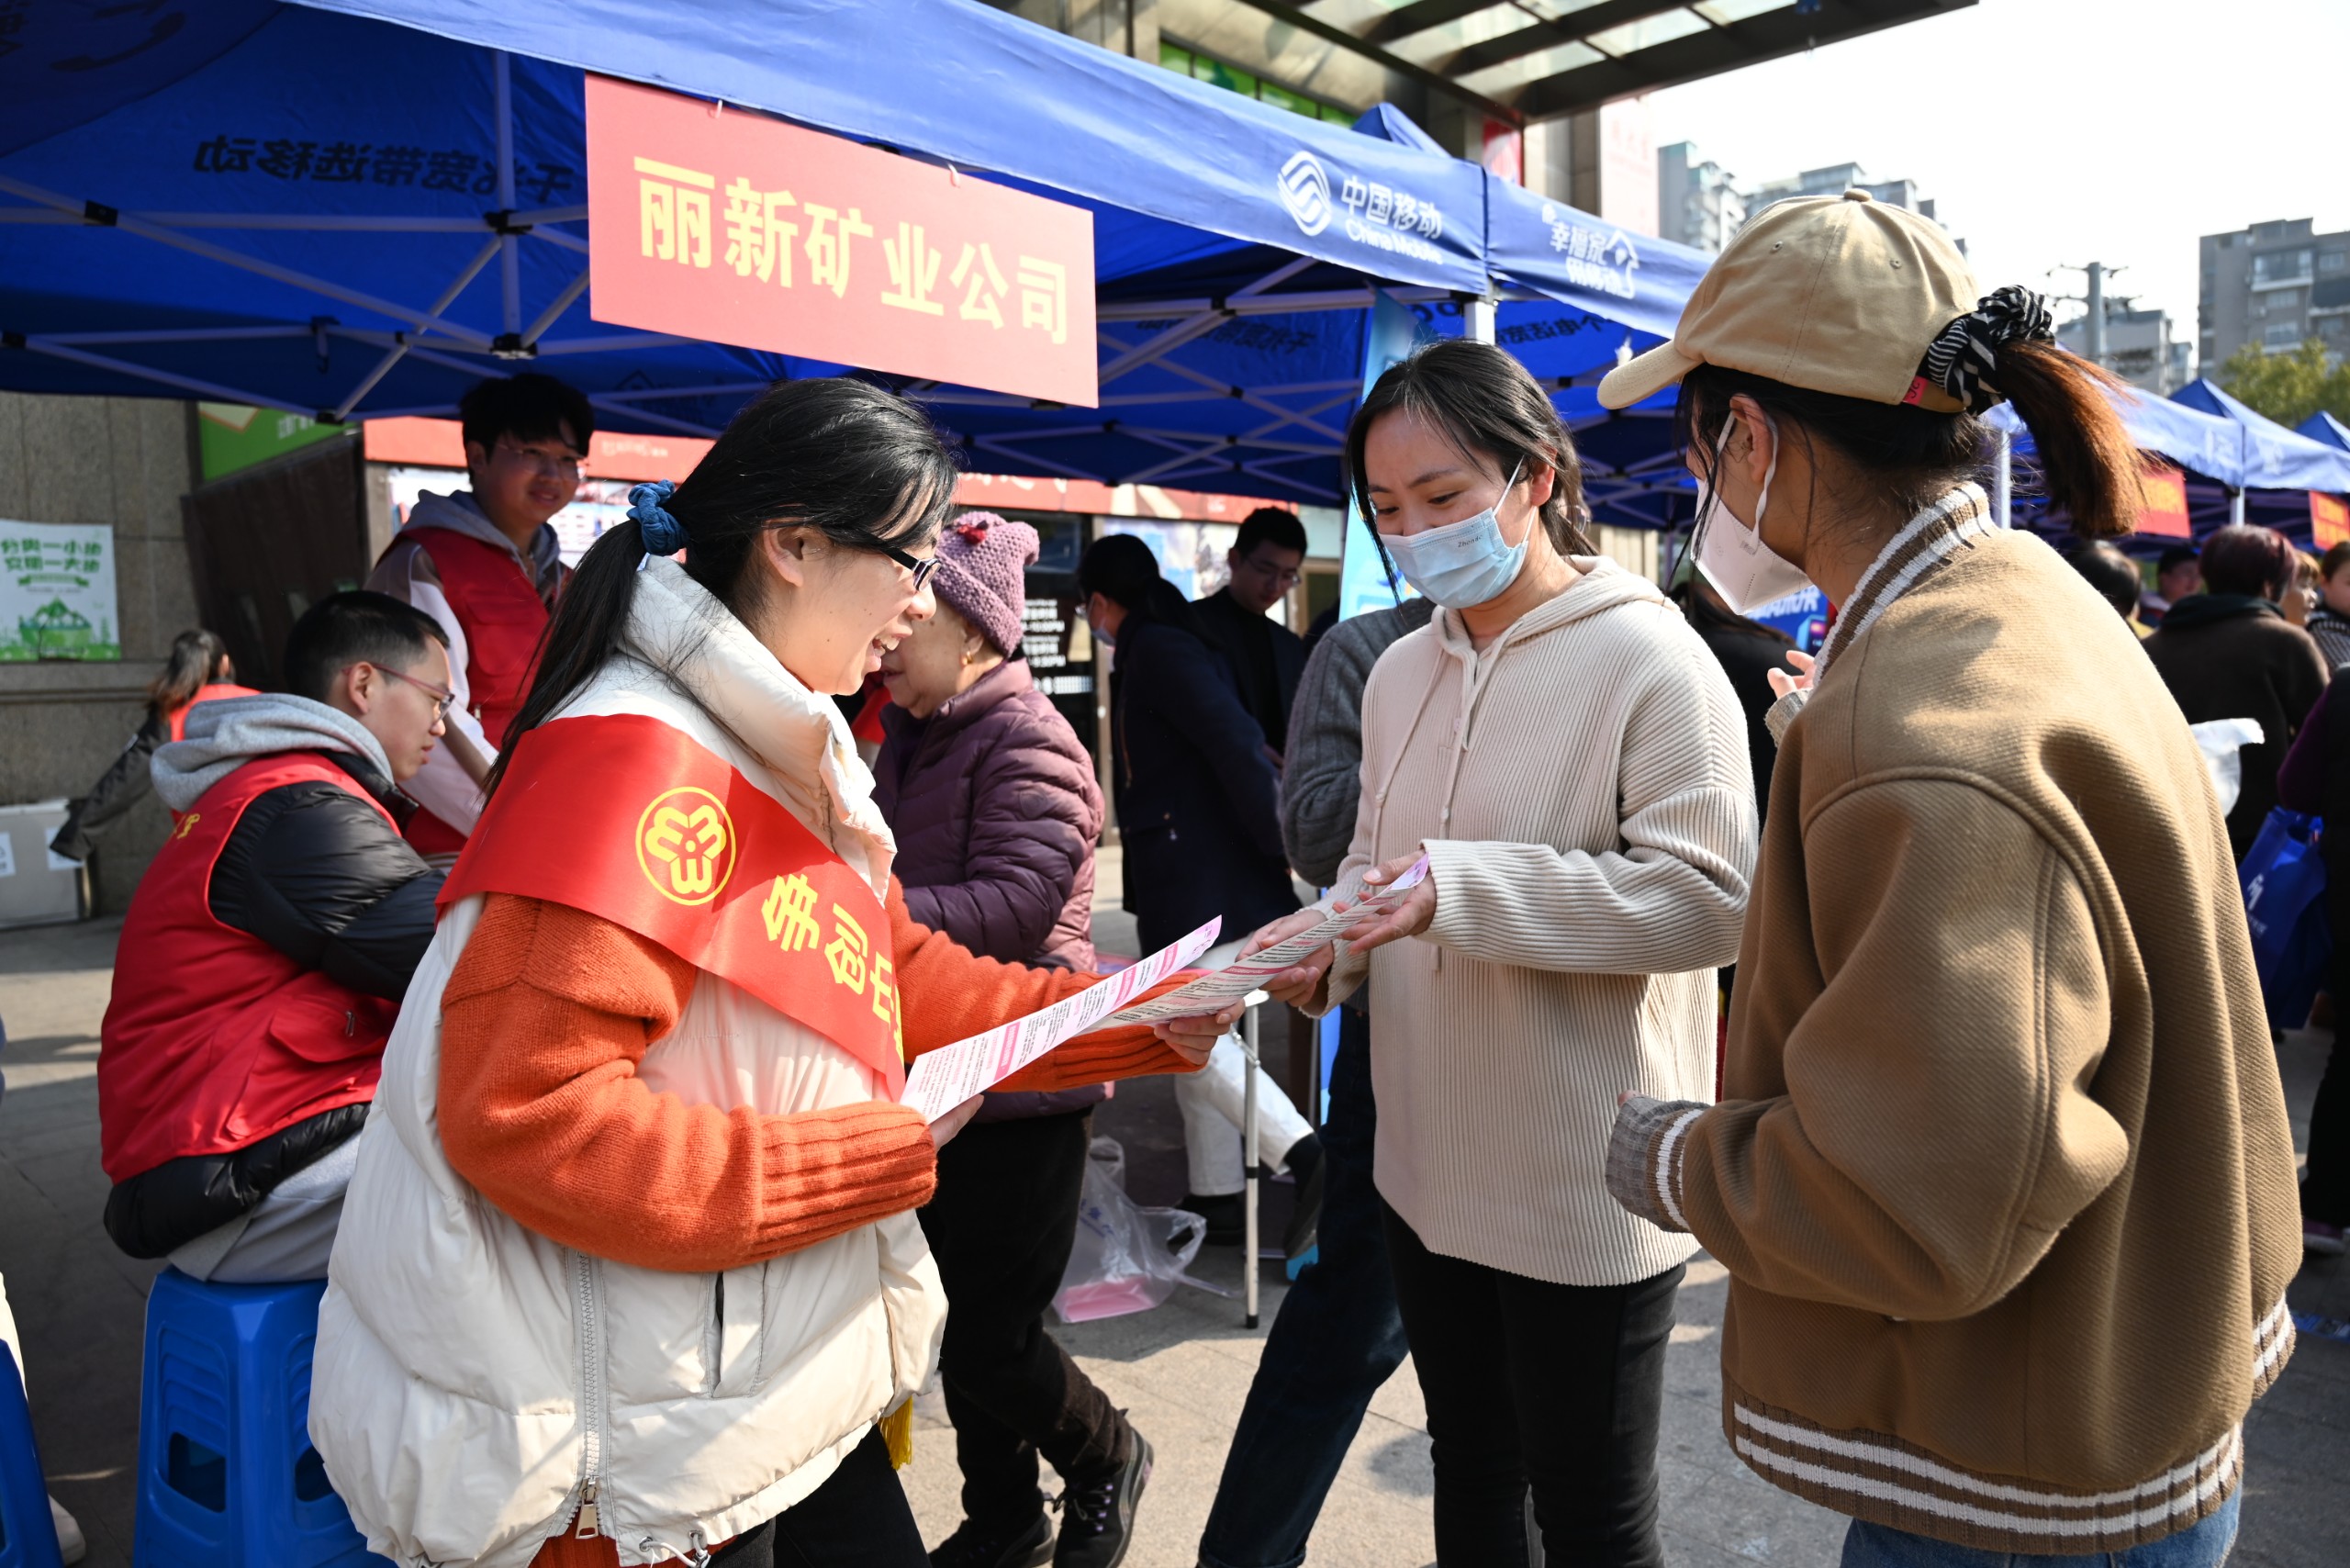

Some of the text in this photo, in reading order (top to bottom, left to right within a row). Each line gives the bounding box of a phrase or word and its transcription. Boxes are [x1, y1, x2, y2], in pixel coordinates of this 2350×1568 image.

[634, 156, 1069, 345] 丽新矿业公司
[1341, 175, 1442, 239] 中国移动
[1345, 218, 1393, 251] China
[760, 873, 904, 1070] 争创巾
